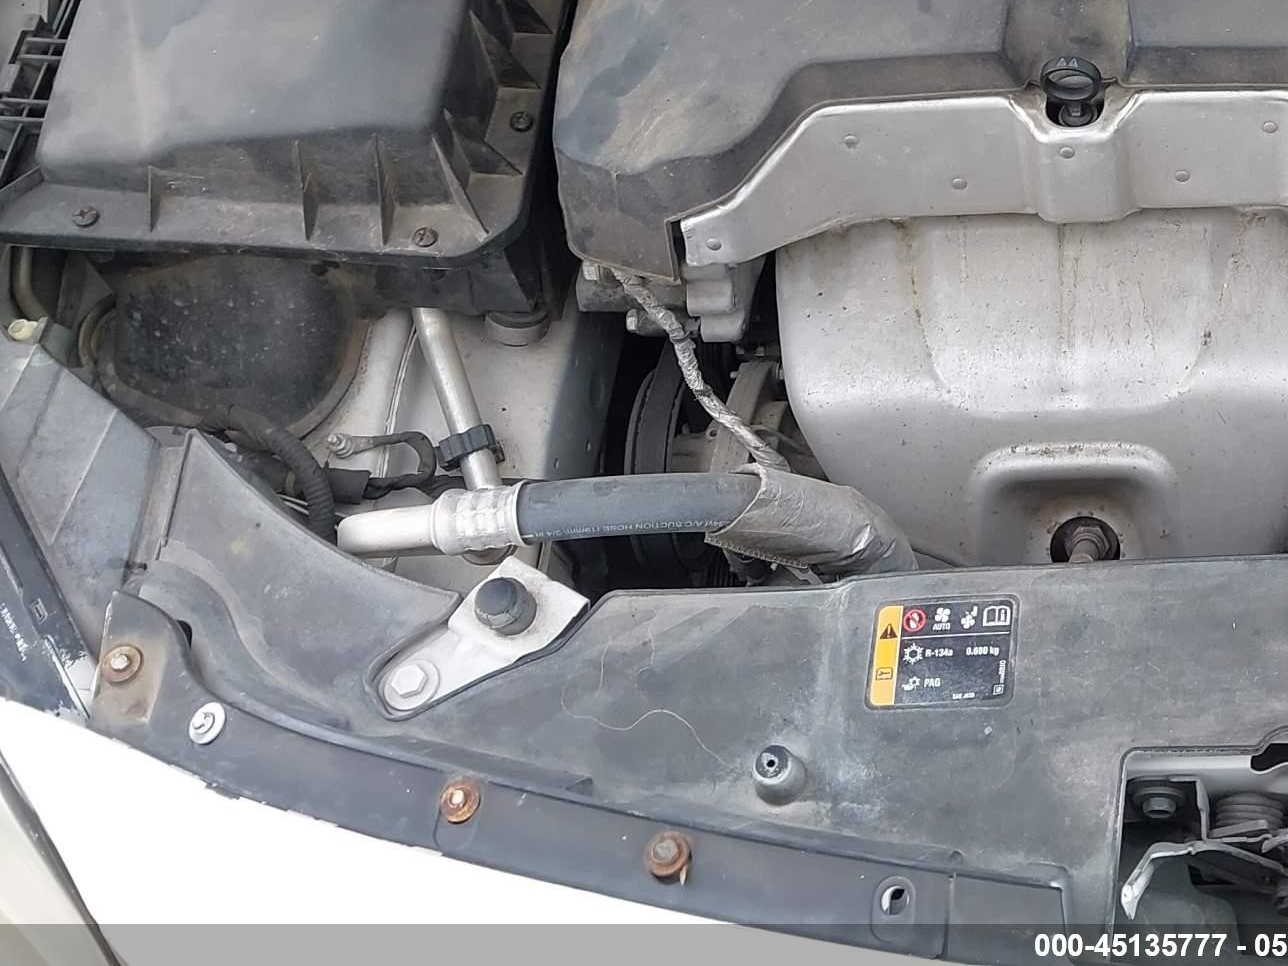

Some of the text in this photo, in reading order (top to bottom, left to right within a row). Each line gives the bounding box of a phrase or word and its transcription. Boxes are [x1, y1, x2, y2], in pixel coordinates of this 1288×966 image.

[603, 523, 633, 532] HOSE
[635, 520, 682, 530] SUCTION
[932, 622, 951, 631] AUTO
[925, 646, 954, 658] R-134a
[989, 645, 1000, 657] kg
[923, 678, 941, 688] PAG
